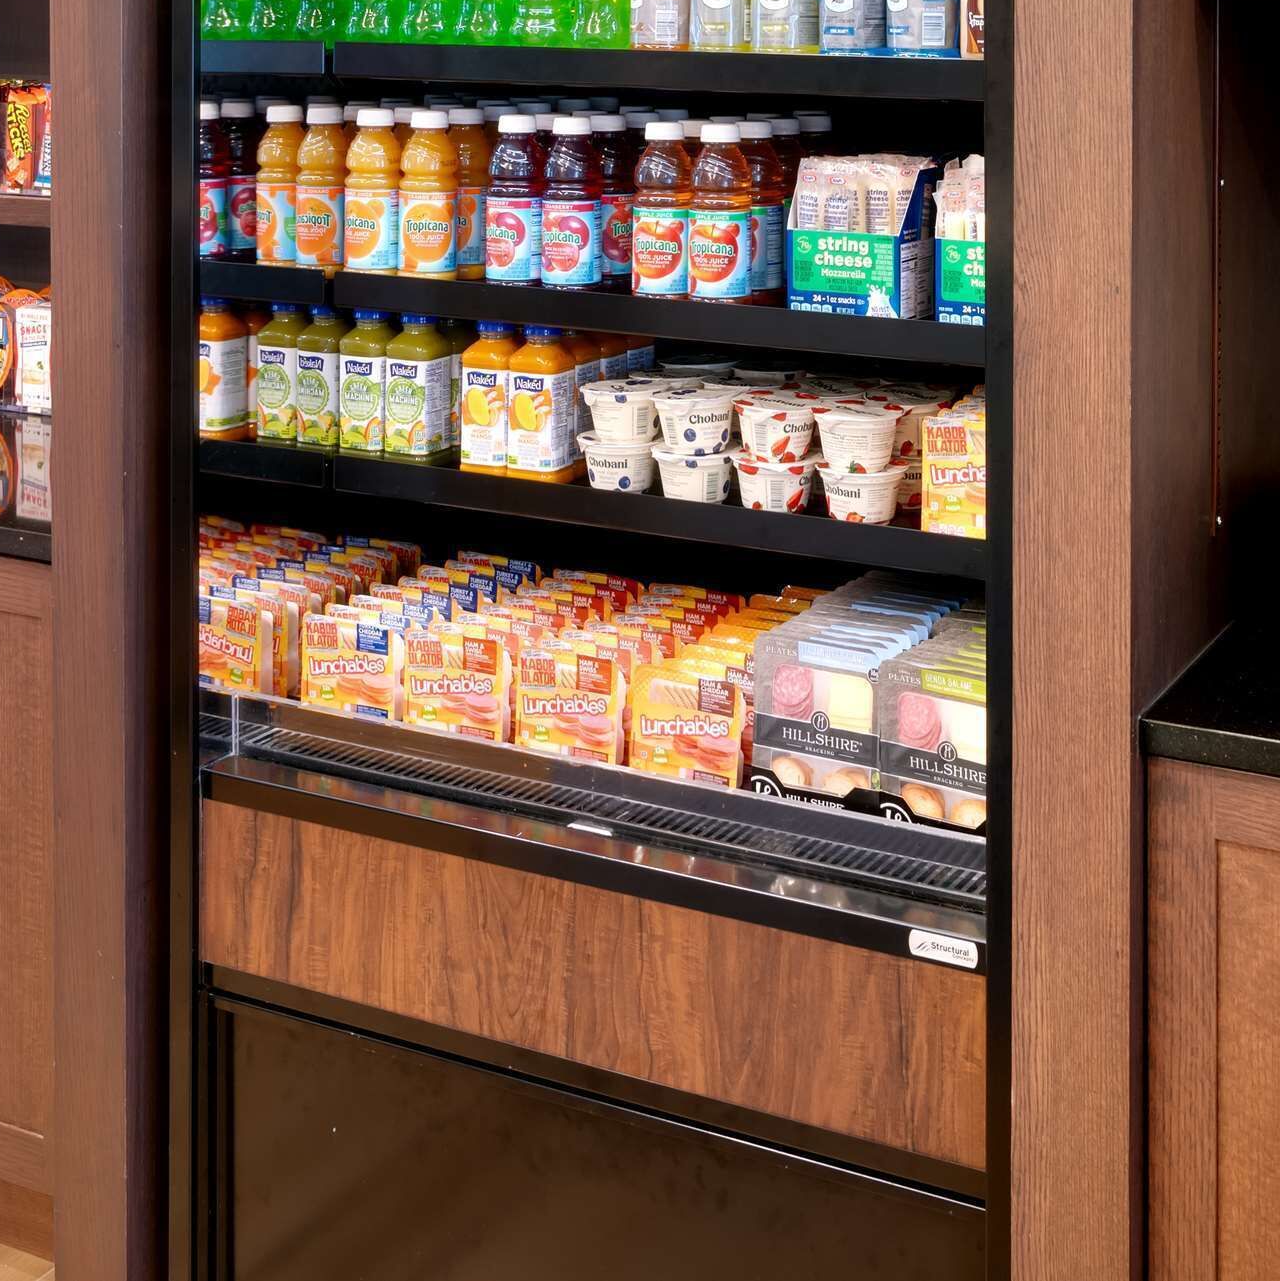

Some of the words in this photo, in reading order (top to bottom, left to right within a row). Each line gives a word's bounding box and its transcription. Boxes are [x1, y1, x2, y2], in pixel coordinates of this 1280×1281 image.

[406, 220, 449, 233] Tropicana
[635, 237, 678, 253] Tropicana
[692, 240, 734, 257] Tropicana
[817, 236, 869, 256] string
[815, 252, 873, 268] cheese
[821, 268, 867, 280] Mozzarella
[689, 410, 730, 425] Chobani
[926, 426, 967, 440] KABOB
[926, 439, 968, 454] ULATOR
[588, 456, 628, 470] Chobani
[930, 461, 986, 486] Luncha
[306, 621, 338, 635] KABOB
[407, 639, 443, 653] KABOB
[309, 656, 386, 676] Lunchables
[410, 675, 493, 695] Lunchables
[524, 694, 607, 715] Lunchables
[641, 714, 729, 737] Lunchables
[782, 727, 860, 753] HILLSHIRE
[909, 755, 987, 784] HILLSHIRE
[931, 941, 970, 957] Structural
